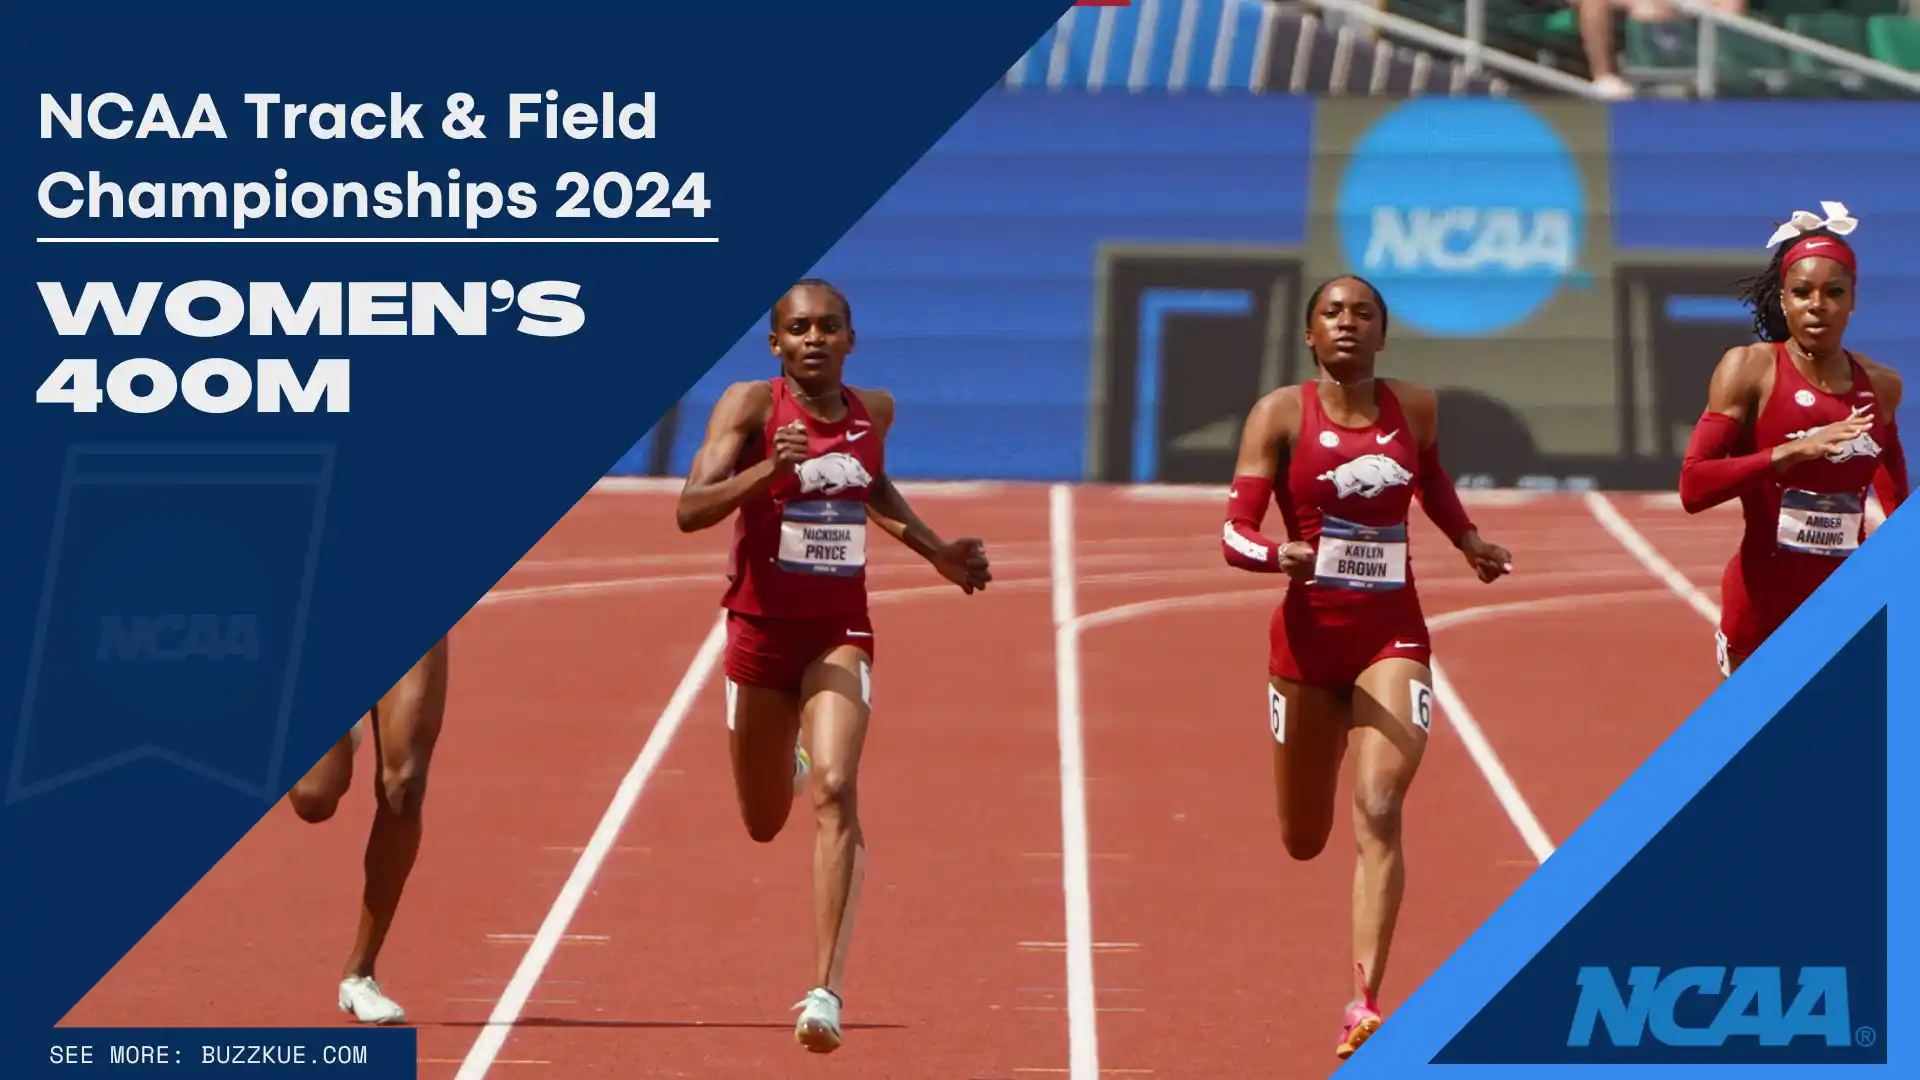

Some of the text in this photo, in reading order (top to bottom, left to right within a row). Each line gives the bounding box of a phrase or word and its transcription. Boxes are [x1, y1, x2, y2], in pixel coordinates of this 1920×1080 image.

[1362, 204, 1574, 270] NCAA
[1805, 515, 1842, 528] AMBER
[803, 527, 851, 541] NICKISHA
[1796, 529, 1844, 546] ANNING
[805, 544, 847, 561] PRYCE
[1345, 545, 1384, 558] KAYLYN
[1338, 559, 1387, 577] BROWN
[1418, 689, 1430, 728] 6
